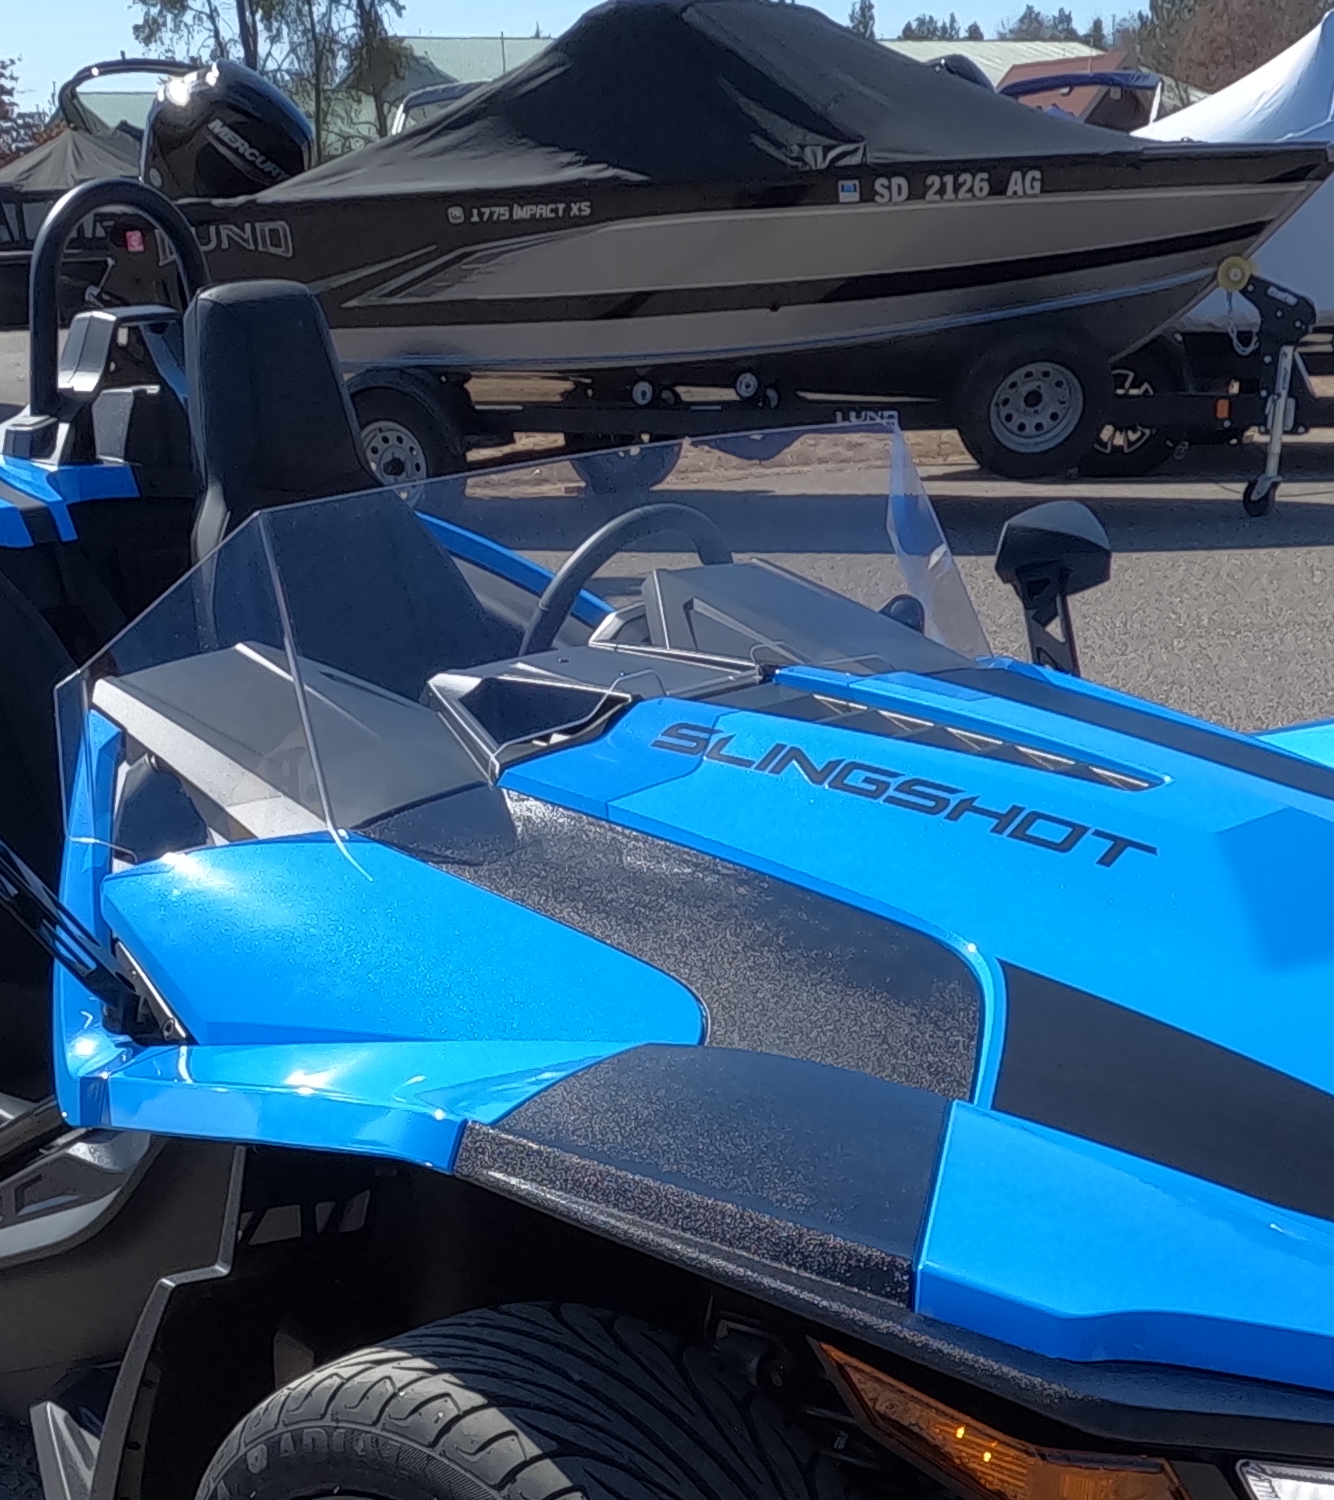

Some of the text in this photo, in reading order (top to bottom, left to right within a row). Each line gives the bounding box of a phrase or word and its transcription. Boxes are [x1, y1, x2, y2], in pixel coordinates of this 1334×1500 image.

[874, 169, 1042, 204] SD 2126 AG
[470, 206, 509, 222] 1775
[512, 202, 566, 220] IMPACT
[569, 201, 591, 217] XS
[650, 722, 1158, 868] SLINGSHOT
